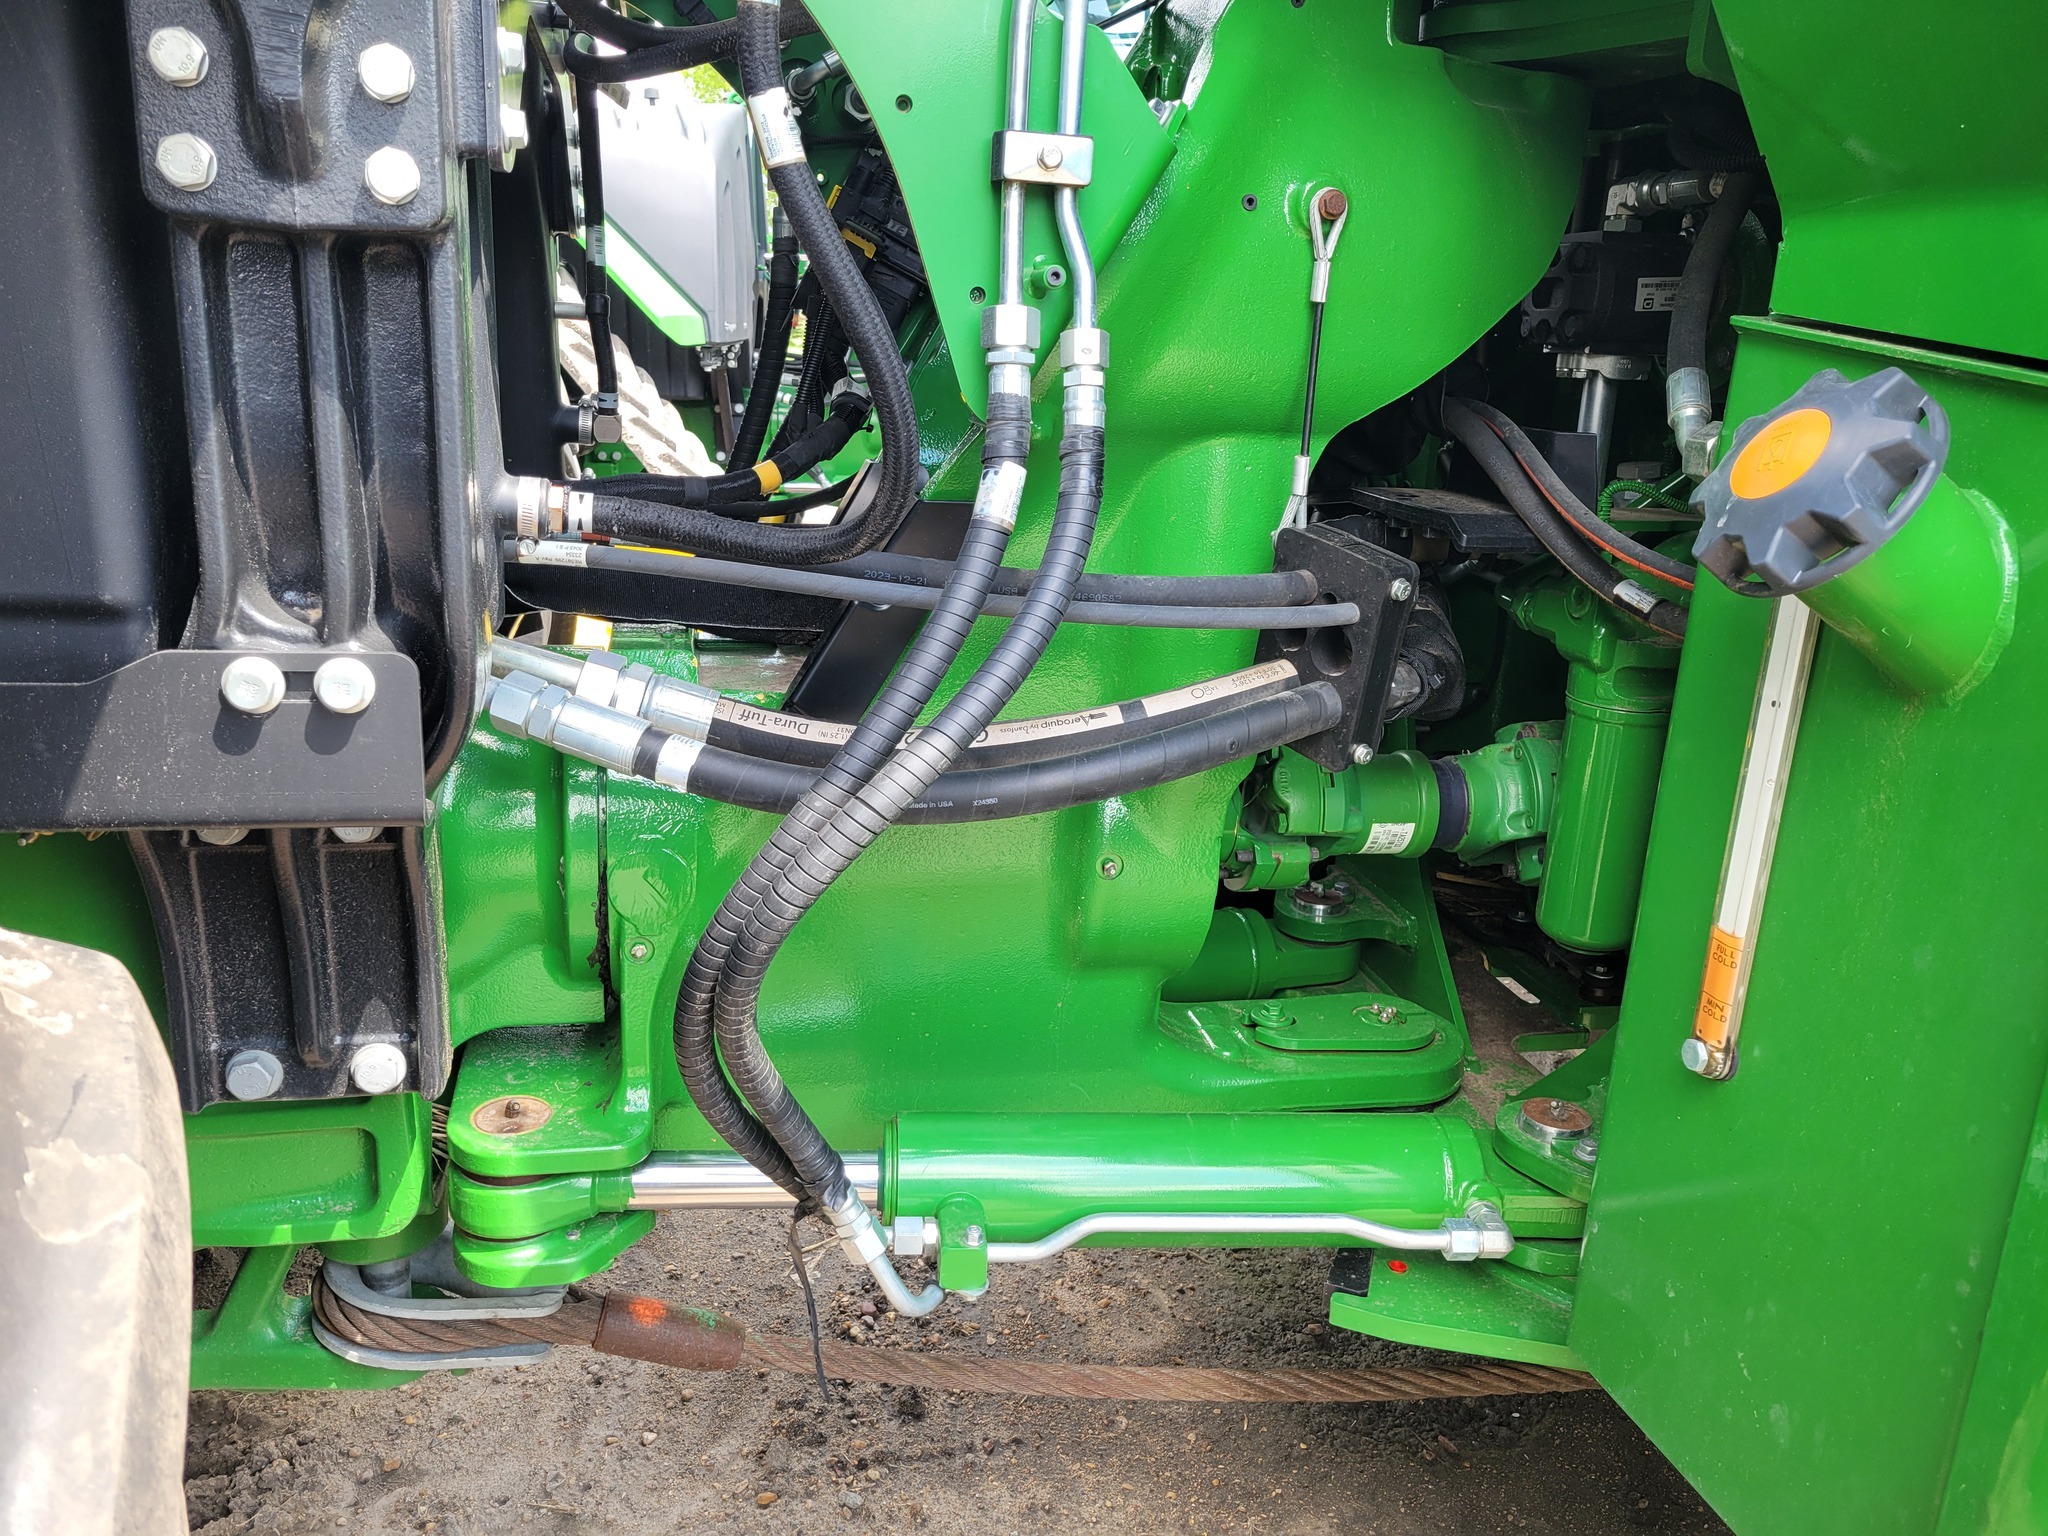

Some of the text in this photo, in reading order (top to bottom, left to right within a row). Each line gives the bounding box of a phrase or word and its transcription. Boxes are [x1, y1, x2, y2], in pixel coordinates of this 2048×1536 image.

[864, 569, 927, 586] 2023-12-21
[738, 708, 809, 735] Dura-Tuff
[999, 725, 1029, 734] Danfoss
[1040, 714, 1092, 730] Aeroquip
[937, 799, 954, 808] USA
[1716, 943, 1736, 960] FULL
[1712, 952, 1738, 970] COLD
[1702, 1005, 1727, 1023] COLD
[1706, 998, 1725, 1013] MIN
